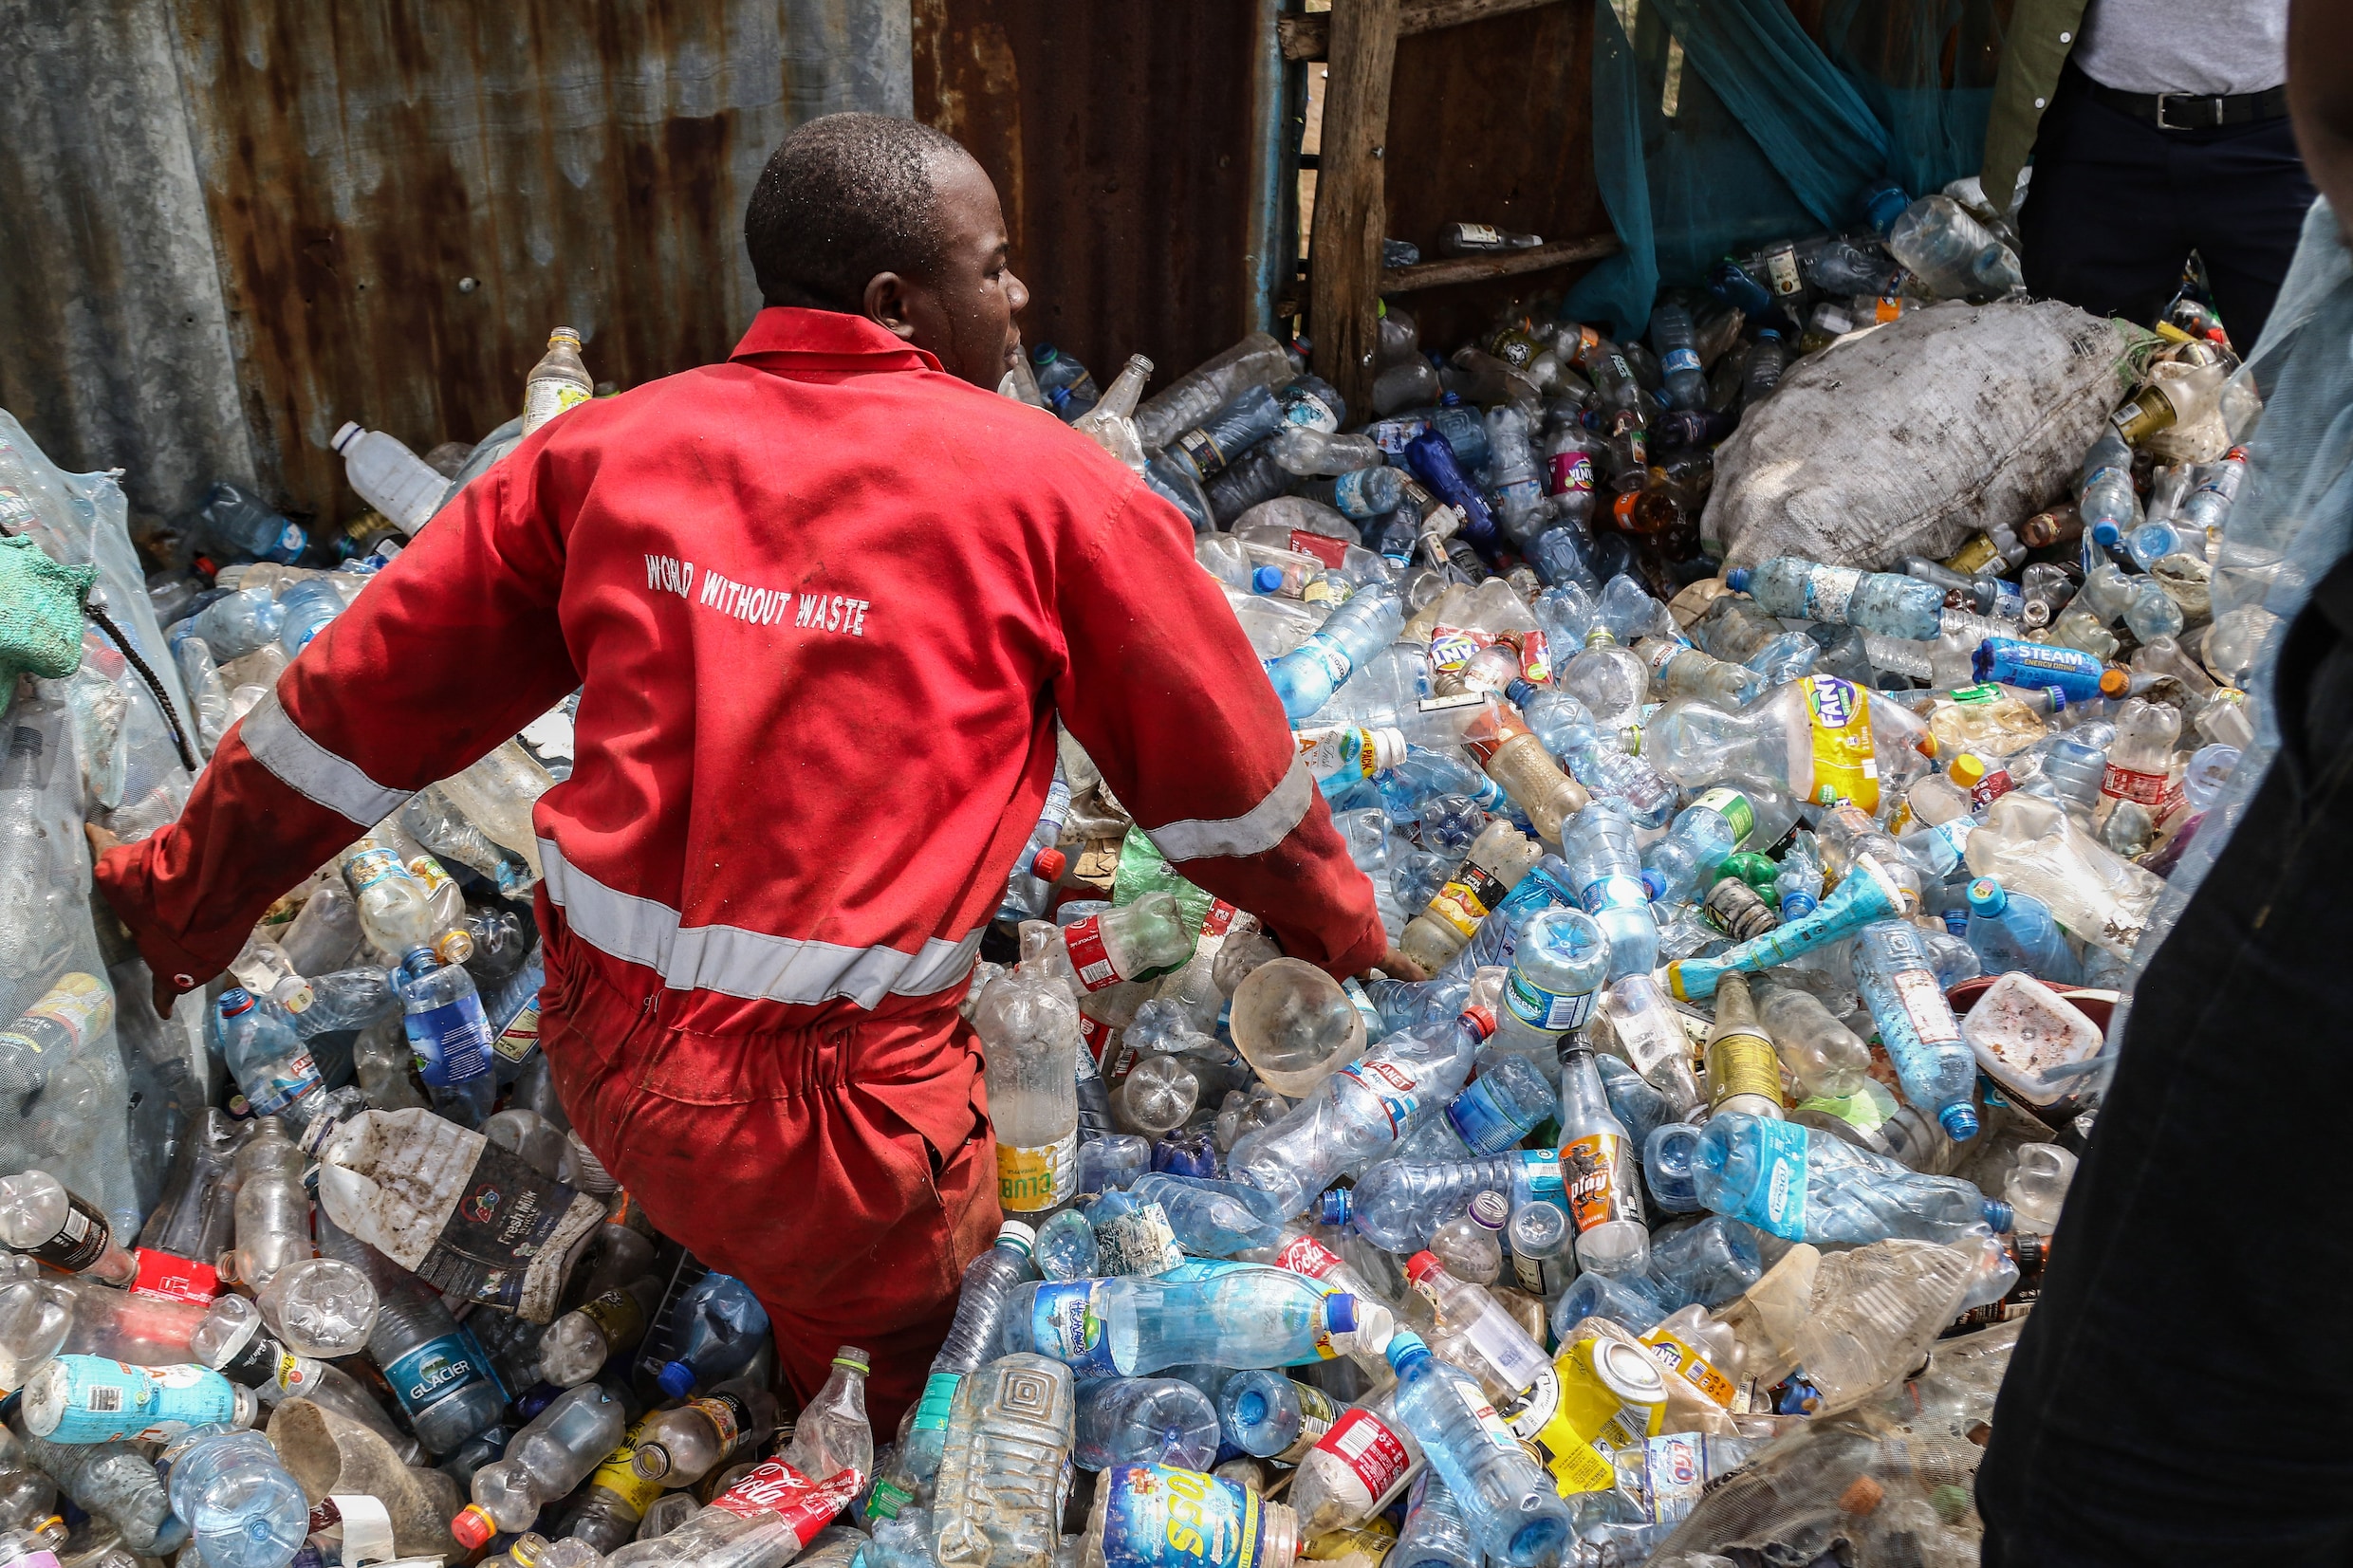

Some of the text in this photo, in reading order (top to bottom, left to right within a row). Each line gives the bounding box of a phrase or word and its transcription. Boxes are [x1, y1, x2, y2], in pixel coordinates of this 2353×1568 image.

[1567, 468, 1594, 483] ANTA
[644, 553, 871, 637] WORLD WITHOUT WASTE
[2018, 645, 2083, 666] STEAM
[2024, 658, 2077, 673] ENERGY DRINK
[1811, 673, 1845, 729] FANT
[1362, 749, 1373, 770] PACK
[1371, 1061, 1408, 1089] PLANET
[1001, 1172, 1053, 1200] CLUB
[1570, 1173, 1608, 1201] play
[497, 1190, 539, 1245] Fresh Milk
[1288, 1238, 1324, 1275] Cola
[1068, 1299, 1090, 1357] HIGHLANDS
[410, 1359, 471, 1400] GLACIER
[1674, 1443, 1695, 1482] EGO
[1159, 1462, 1214, 1559] TOSS
[1247, 1517, 1256, 1531] THE
[1243, 1532, 1254, 1557] FIRST
